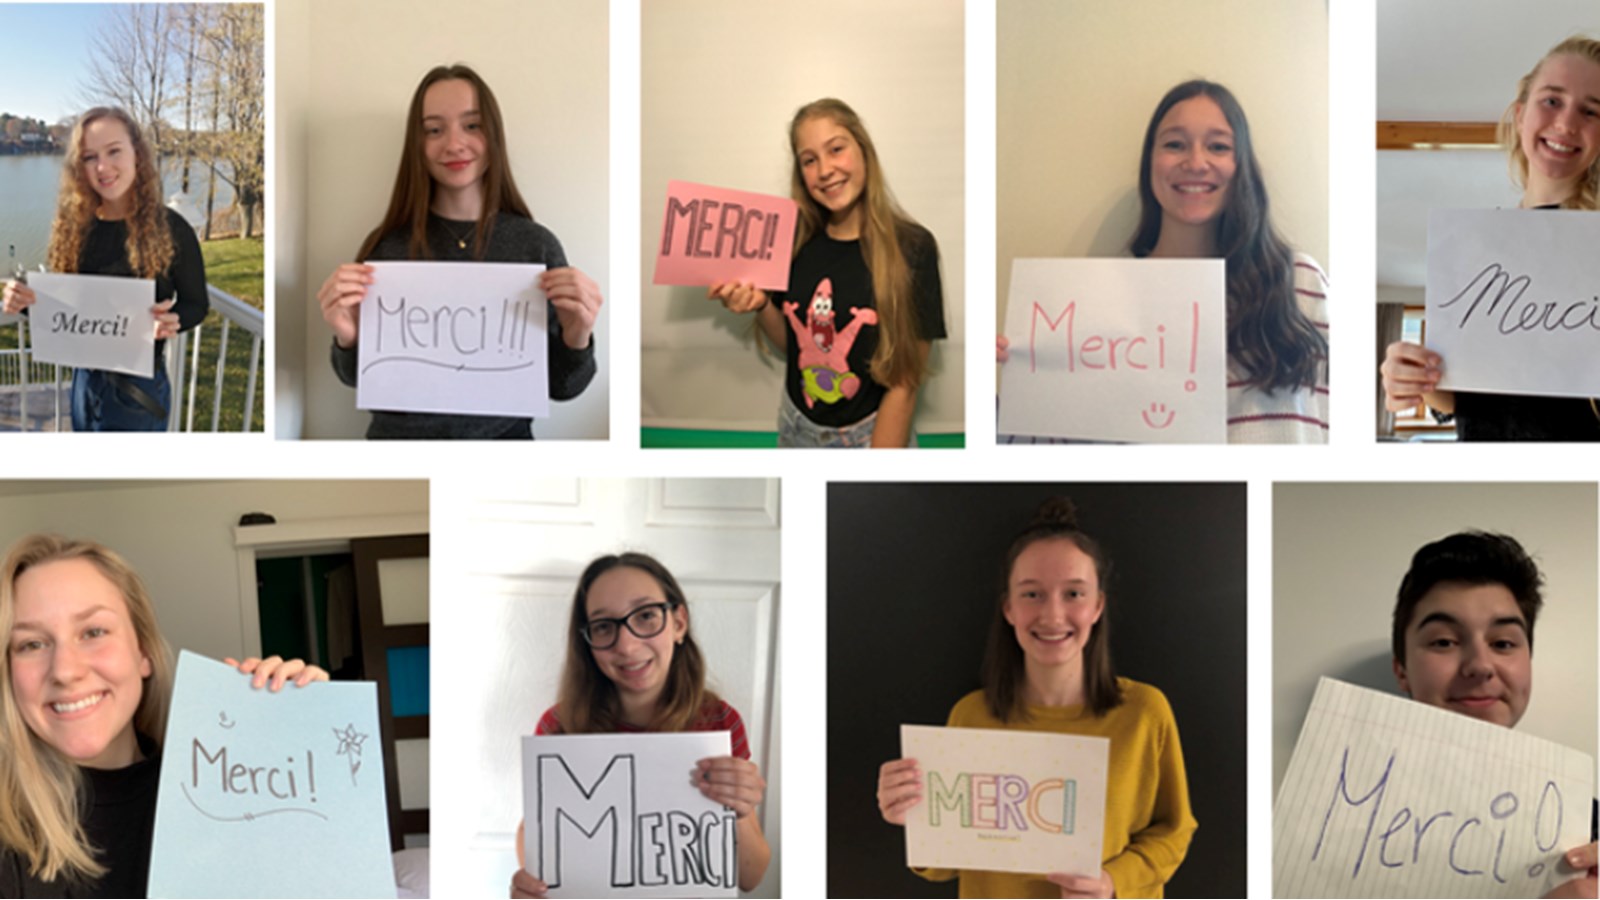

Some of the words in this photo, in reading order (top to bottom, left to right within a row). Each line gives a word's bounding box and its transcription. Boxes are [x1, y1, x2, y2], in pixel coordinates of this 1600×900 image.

[661, 196, 779, 260] MERCI!
[51, 310, 130, 338] Merci!
[1438, 262, 1600, 335] Merci
[192, 737, 318, 804] Merci!
[927, 770, 1077, 835] MERCI
[1311, 747, 1564, 884] Merci!
